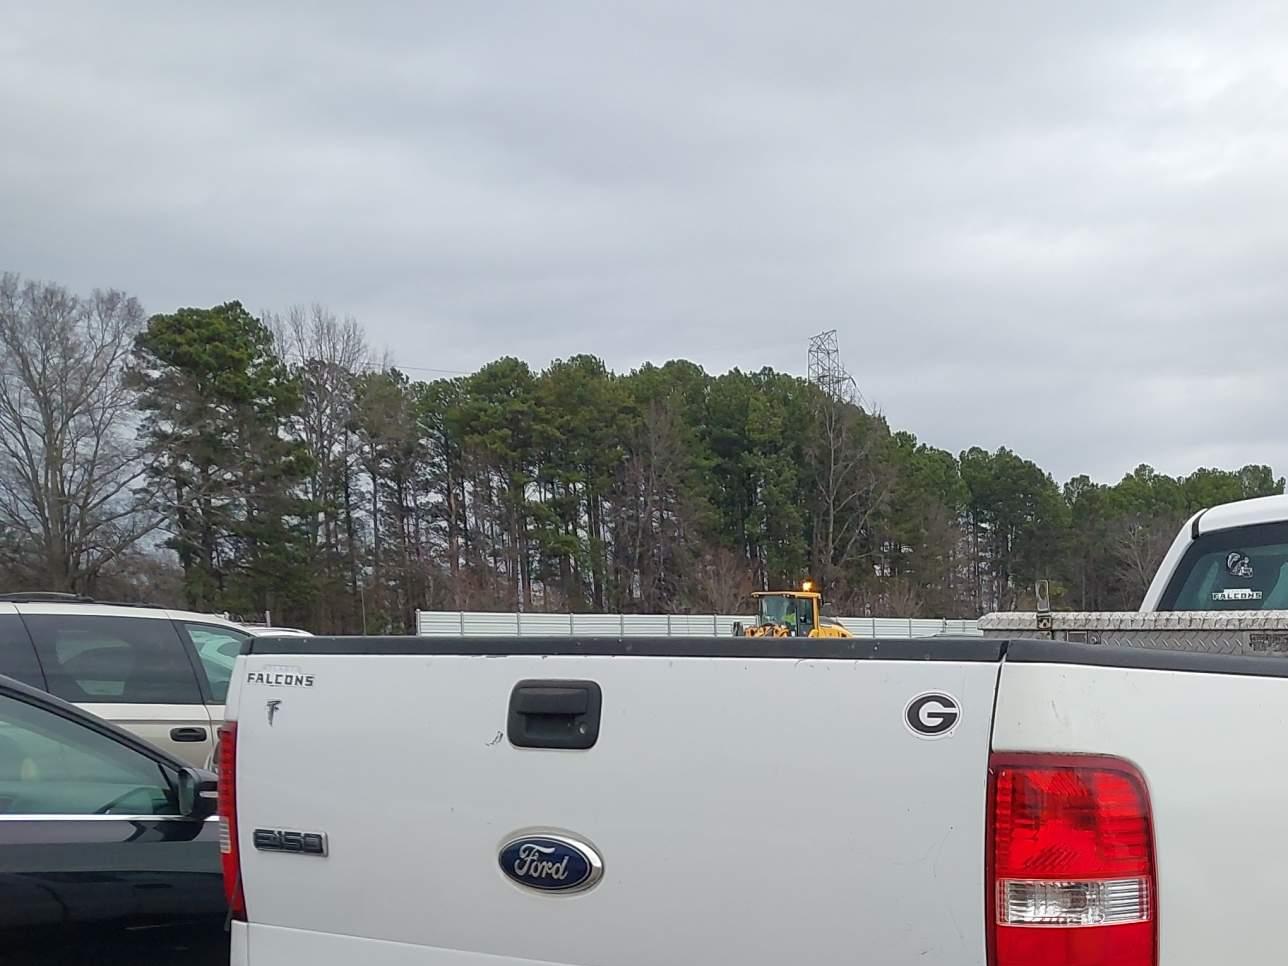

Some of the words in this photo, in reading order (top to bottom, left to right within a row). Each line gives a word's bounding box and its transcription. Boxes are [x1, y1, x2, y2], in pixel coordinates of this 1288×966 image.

[1212, 592, 1262, 600] FALCONS
[247, 672, 314, 687] FALCONS
[907, 695, 958, 734] G
[514, 843, 569, 879] Ford
